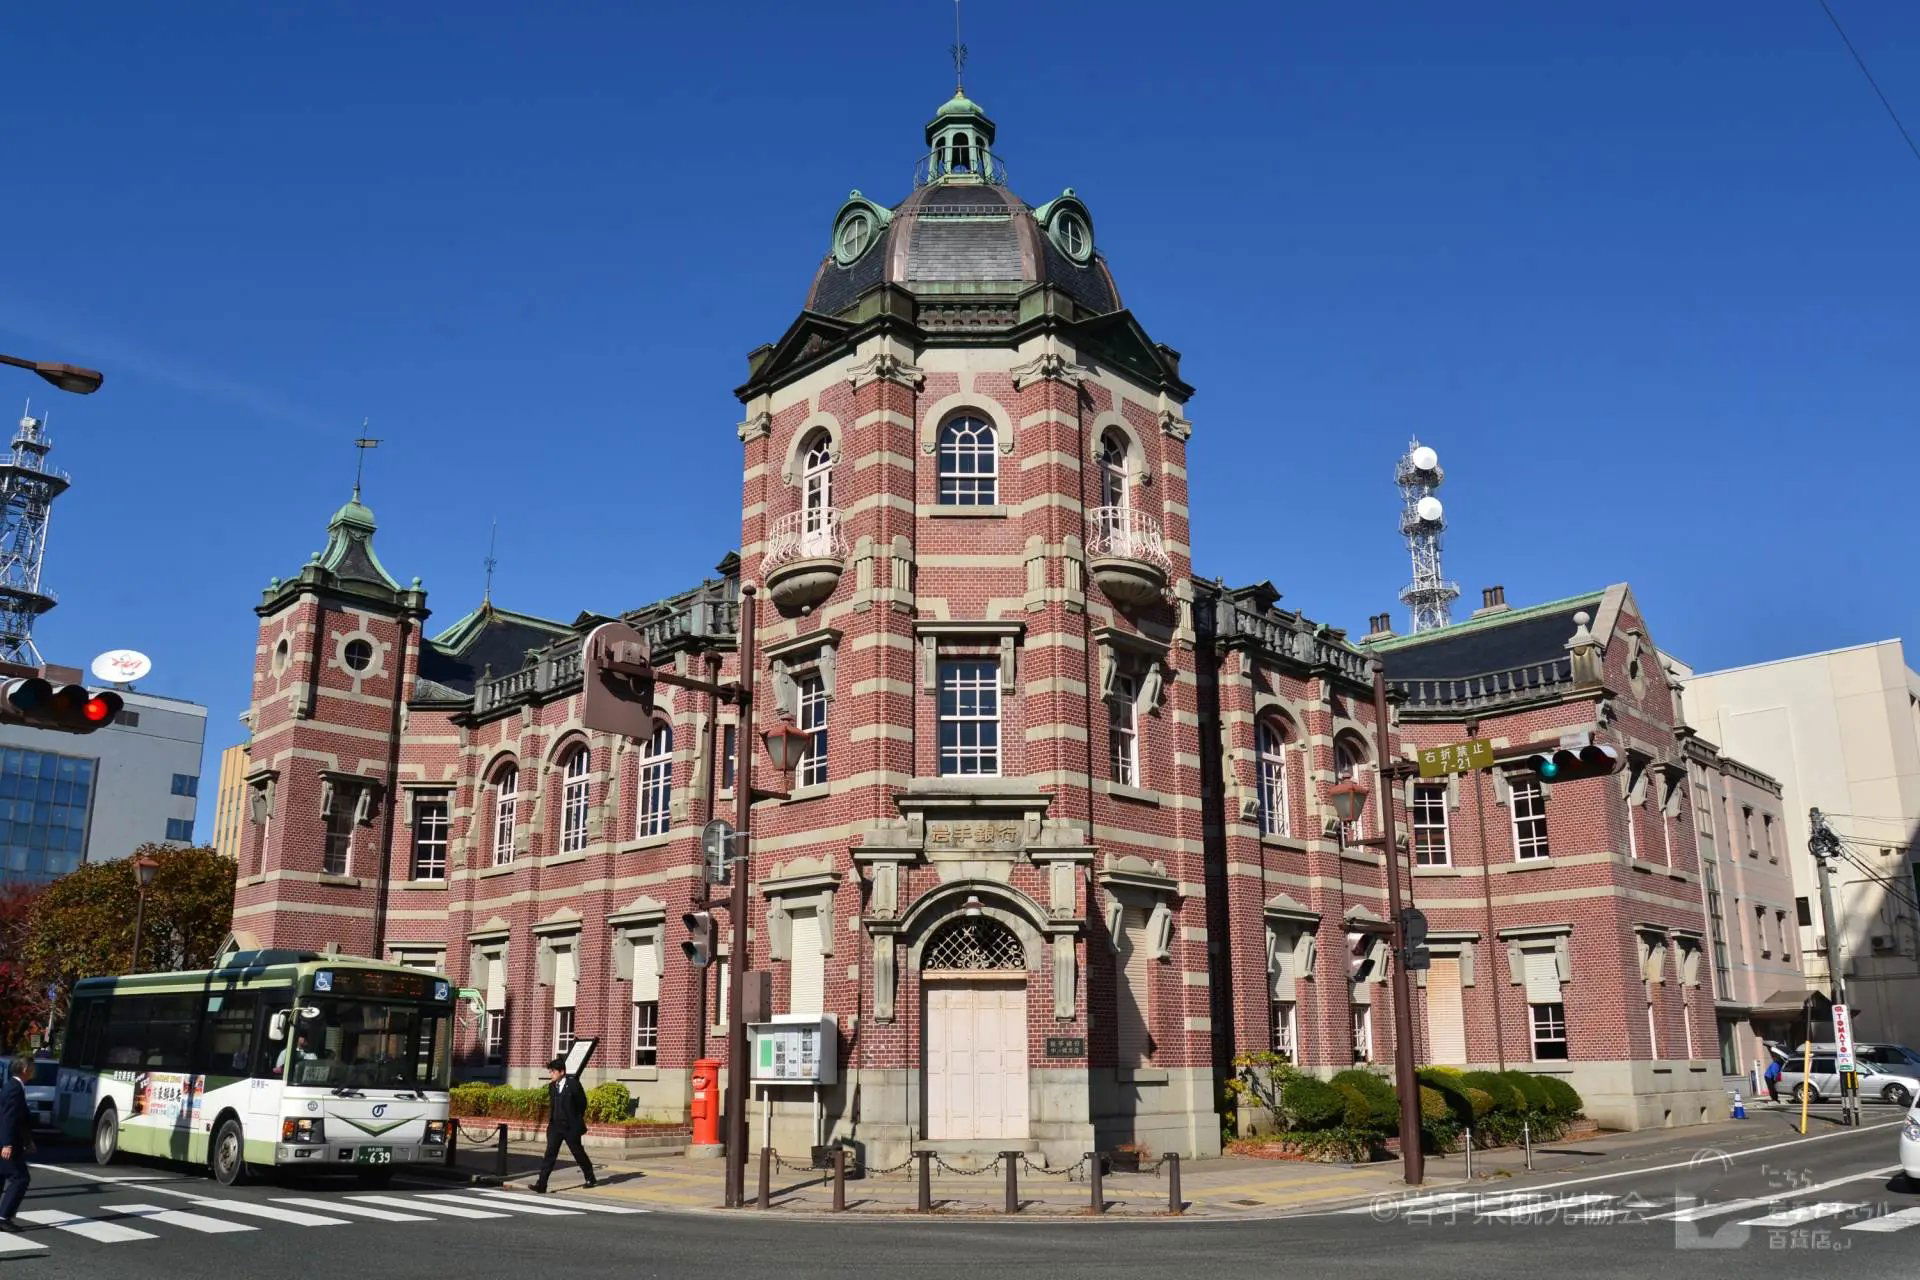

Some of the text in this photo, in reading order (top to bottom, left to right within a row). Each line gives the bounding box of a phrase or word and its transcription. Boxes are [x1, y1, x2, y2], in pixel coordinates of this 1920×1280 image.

[1425, 742, 1484, 763] 右折禁止
[1441, 756, 1471, 772] 7-21
[932, 824, 1017, 843] 岩手銀行
[1837, 1013, 1847, 1053] TOMATO
